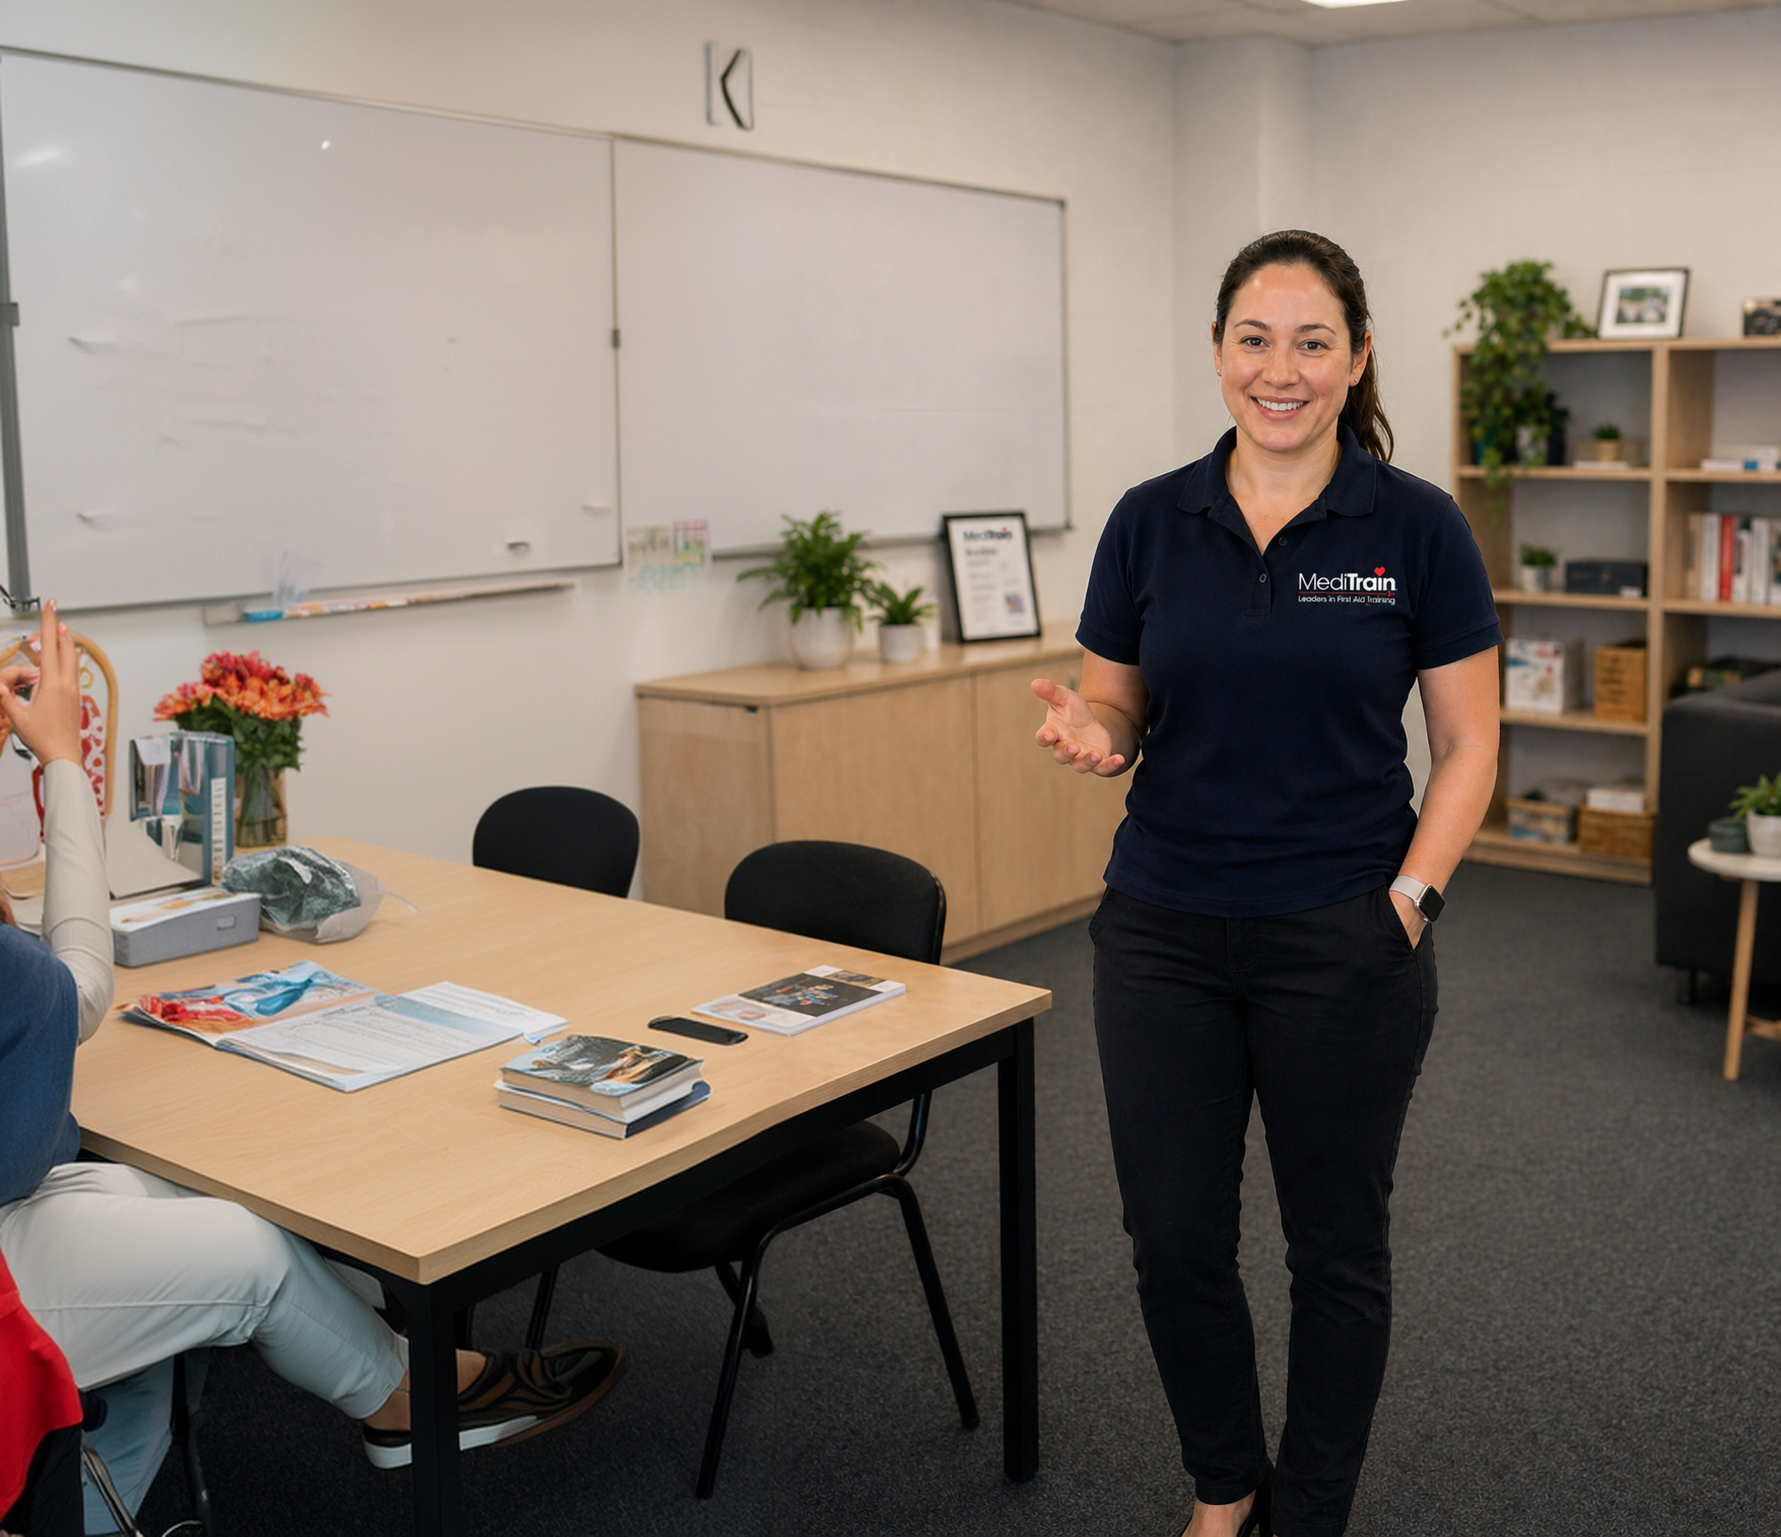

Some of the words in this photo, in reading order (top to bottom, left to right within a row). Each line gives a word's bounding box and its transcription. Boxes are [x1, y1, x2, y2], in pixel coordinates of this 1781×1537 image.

[1298, 571, 1397, 591] MediTrain
[1298, 595, 1327, 603] Leaders
[1328, 595, 1336, 603] in
[1337, 595, 1352, 603] First
[1353, 595, 1366, 603] Aid
[1367, 595, 1396, 605] Training
